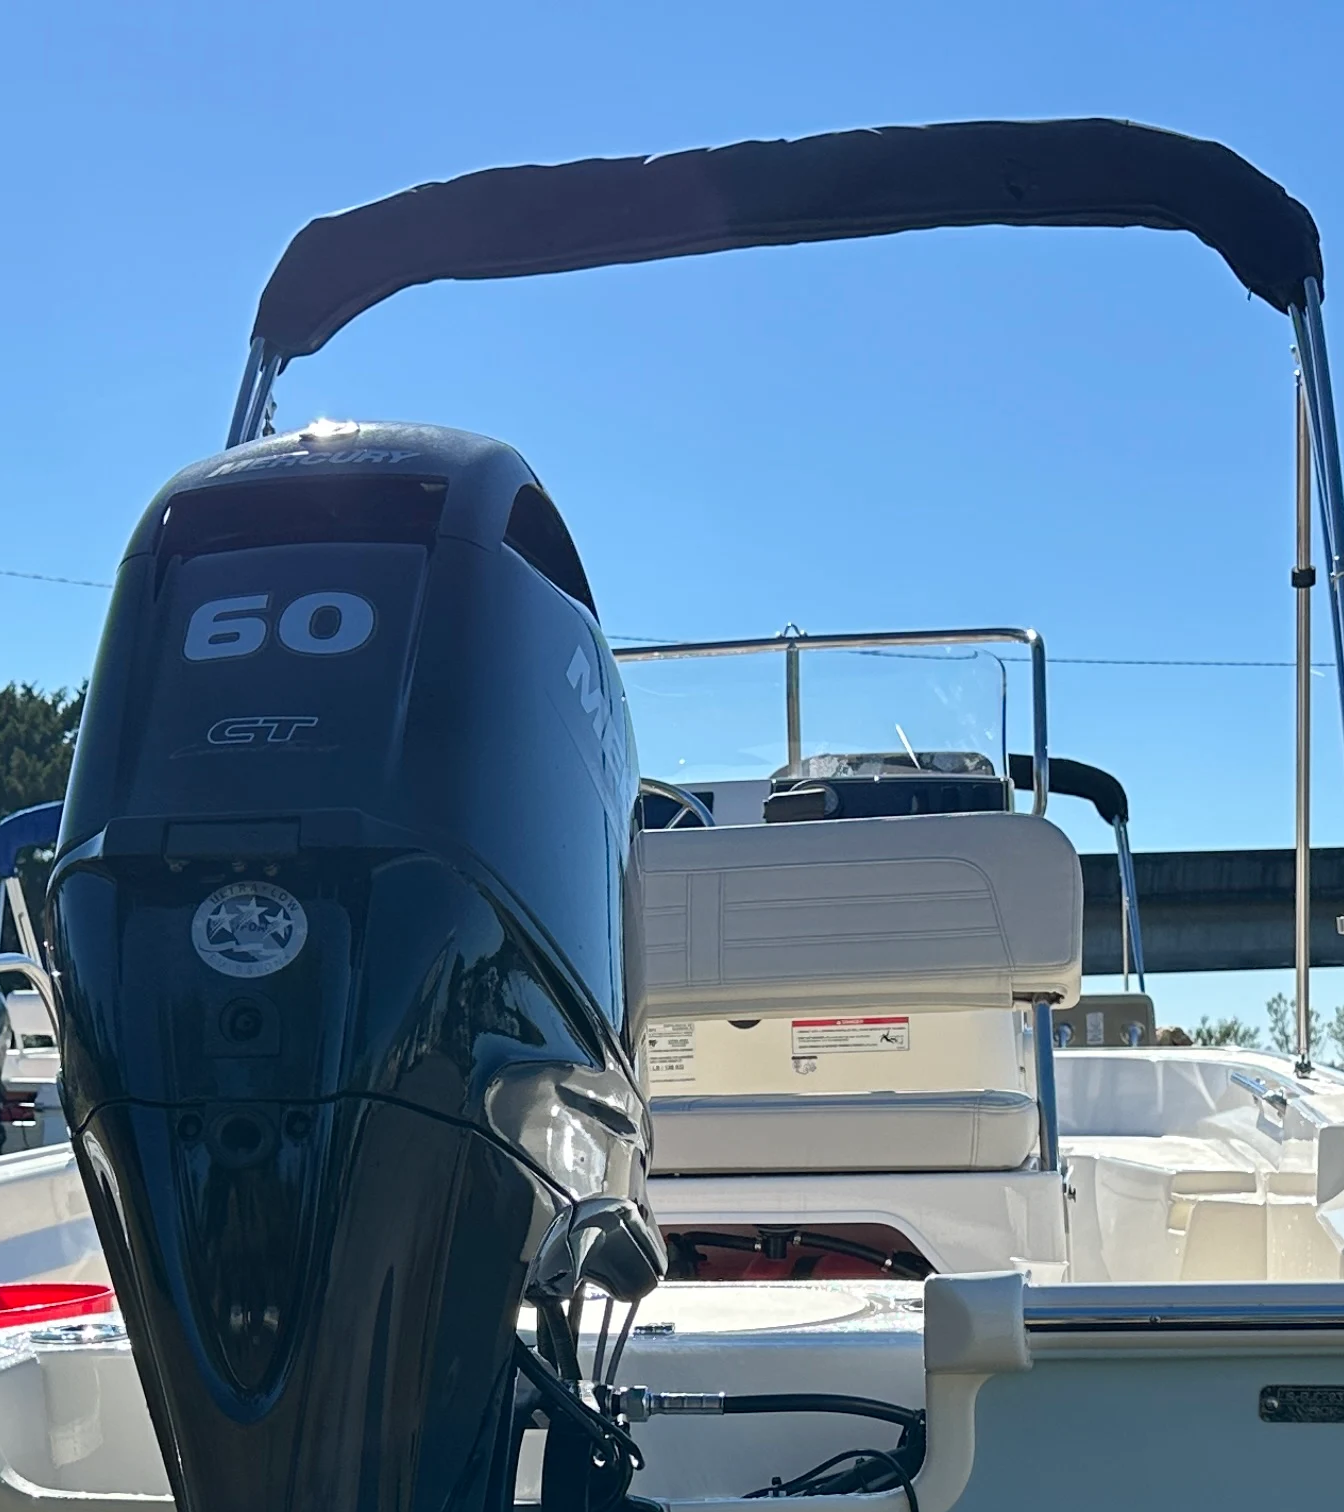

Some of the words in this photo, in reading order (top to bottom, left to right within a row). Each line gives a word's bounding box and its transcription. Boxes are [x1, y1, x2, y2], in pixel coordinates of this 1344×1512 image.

[205, 449, 421, 479] MERCURY
[183, 591, 375, 661] 60
[210, 884, 258, 904] ULTRA
[270, 888, 299, 911] LOW
